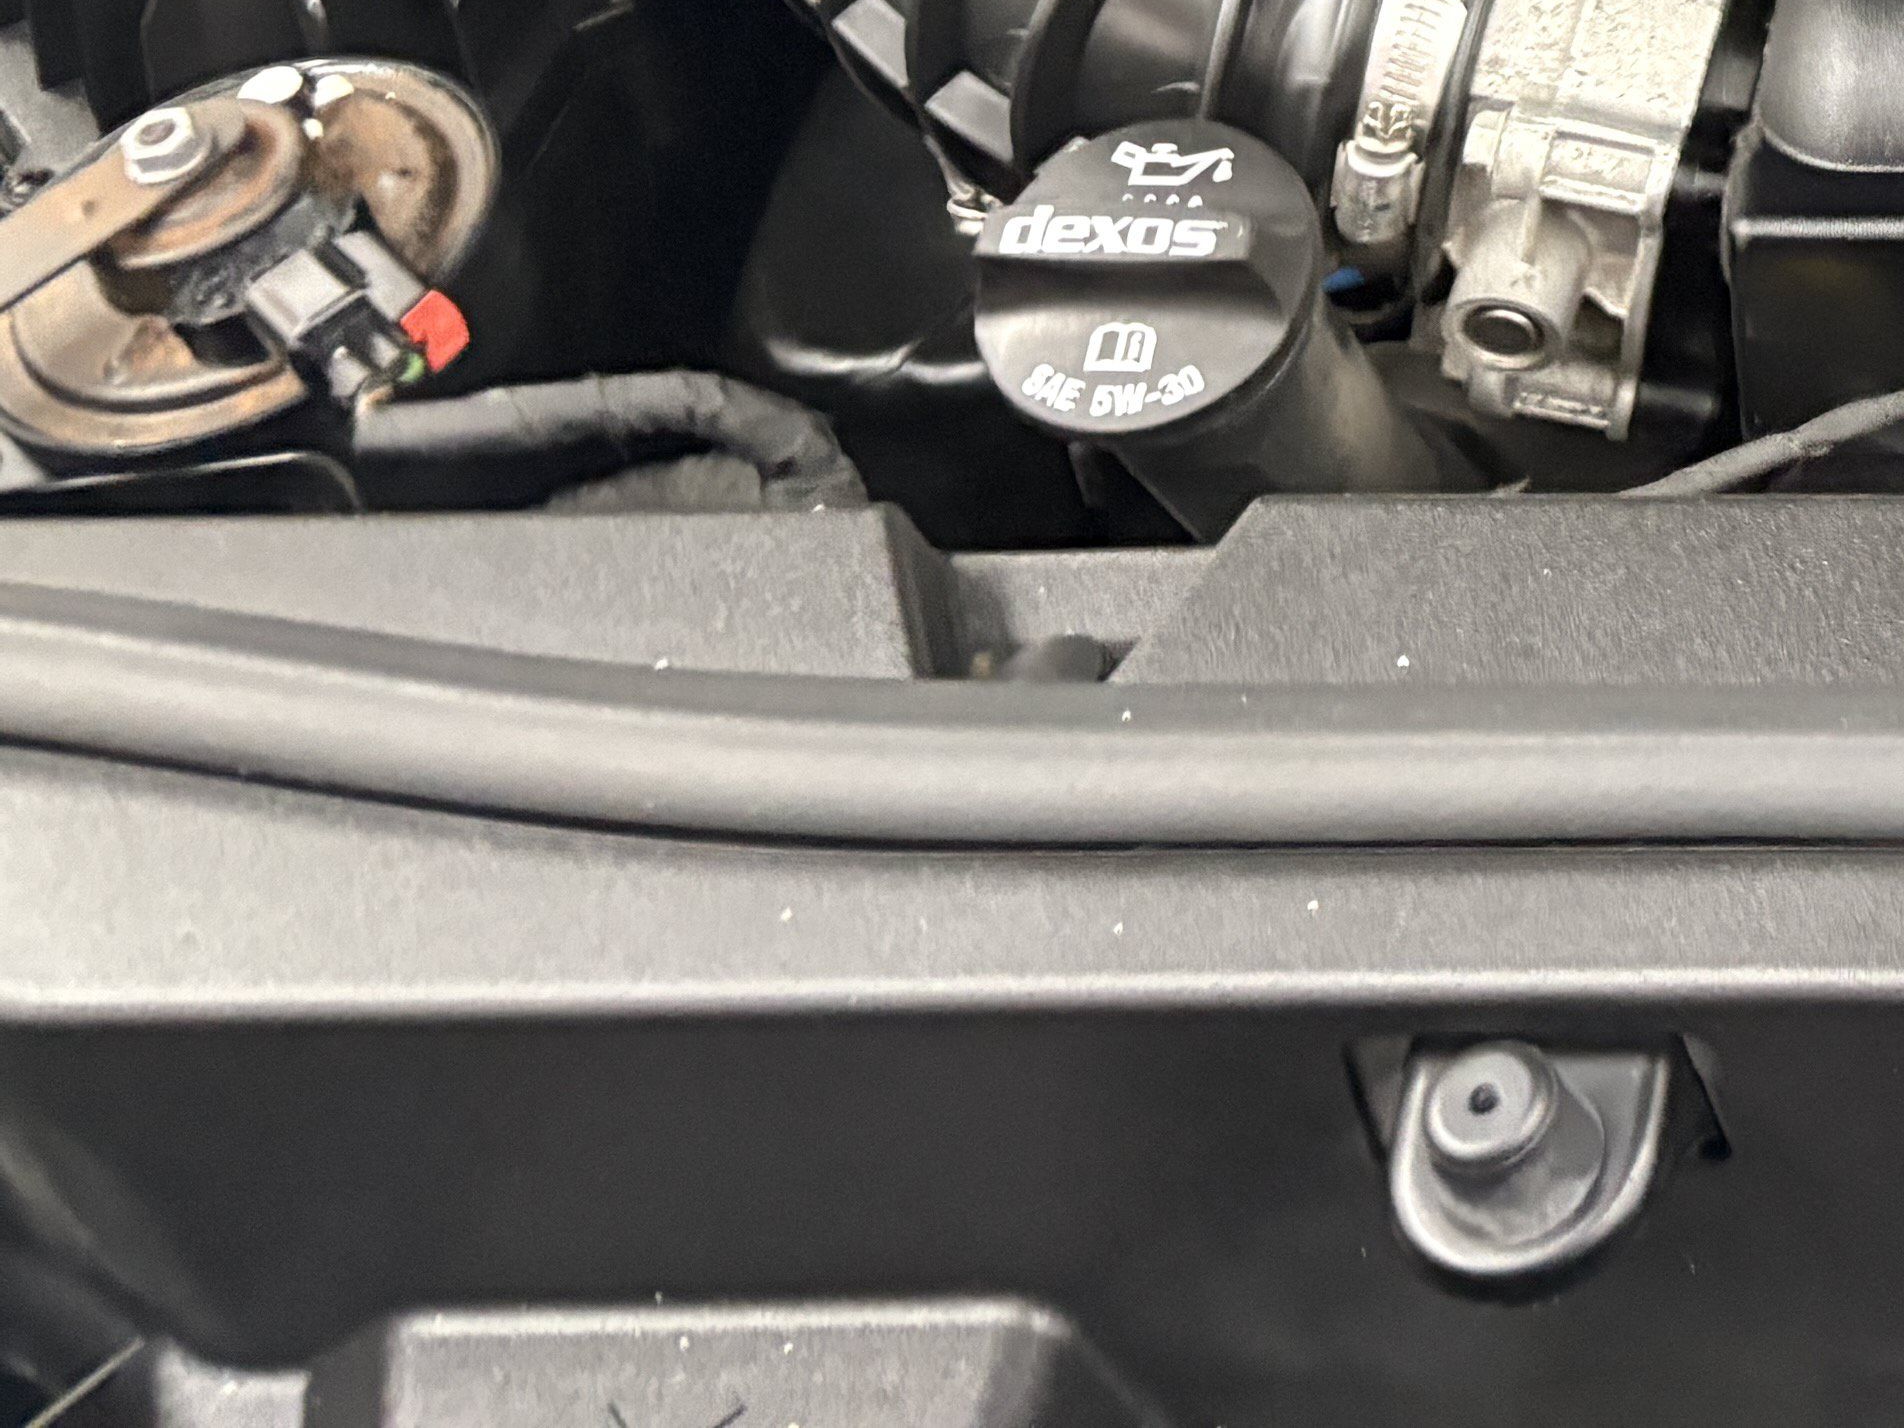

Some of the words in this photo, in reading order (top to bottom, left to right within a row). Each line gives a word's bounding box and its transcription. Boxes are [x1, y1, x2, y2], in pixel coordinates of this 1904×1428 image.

[998, 204, 1221, 257] dexos
[1021, 363, 1087, 412] SAE
[1089, 364, 1206, 417] 5W-30
